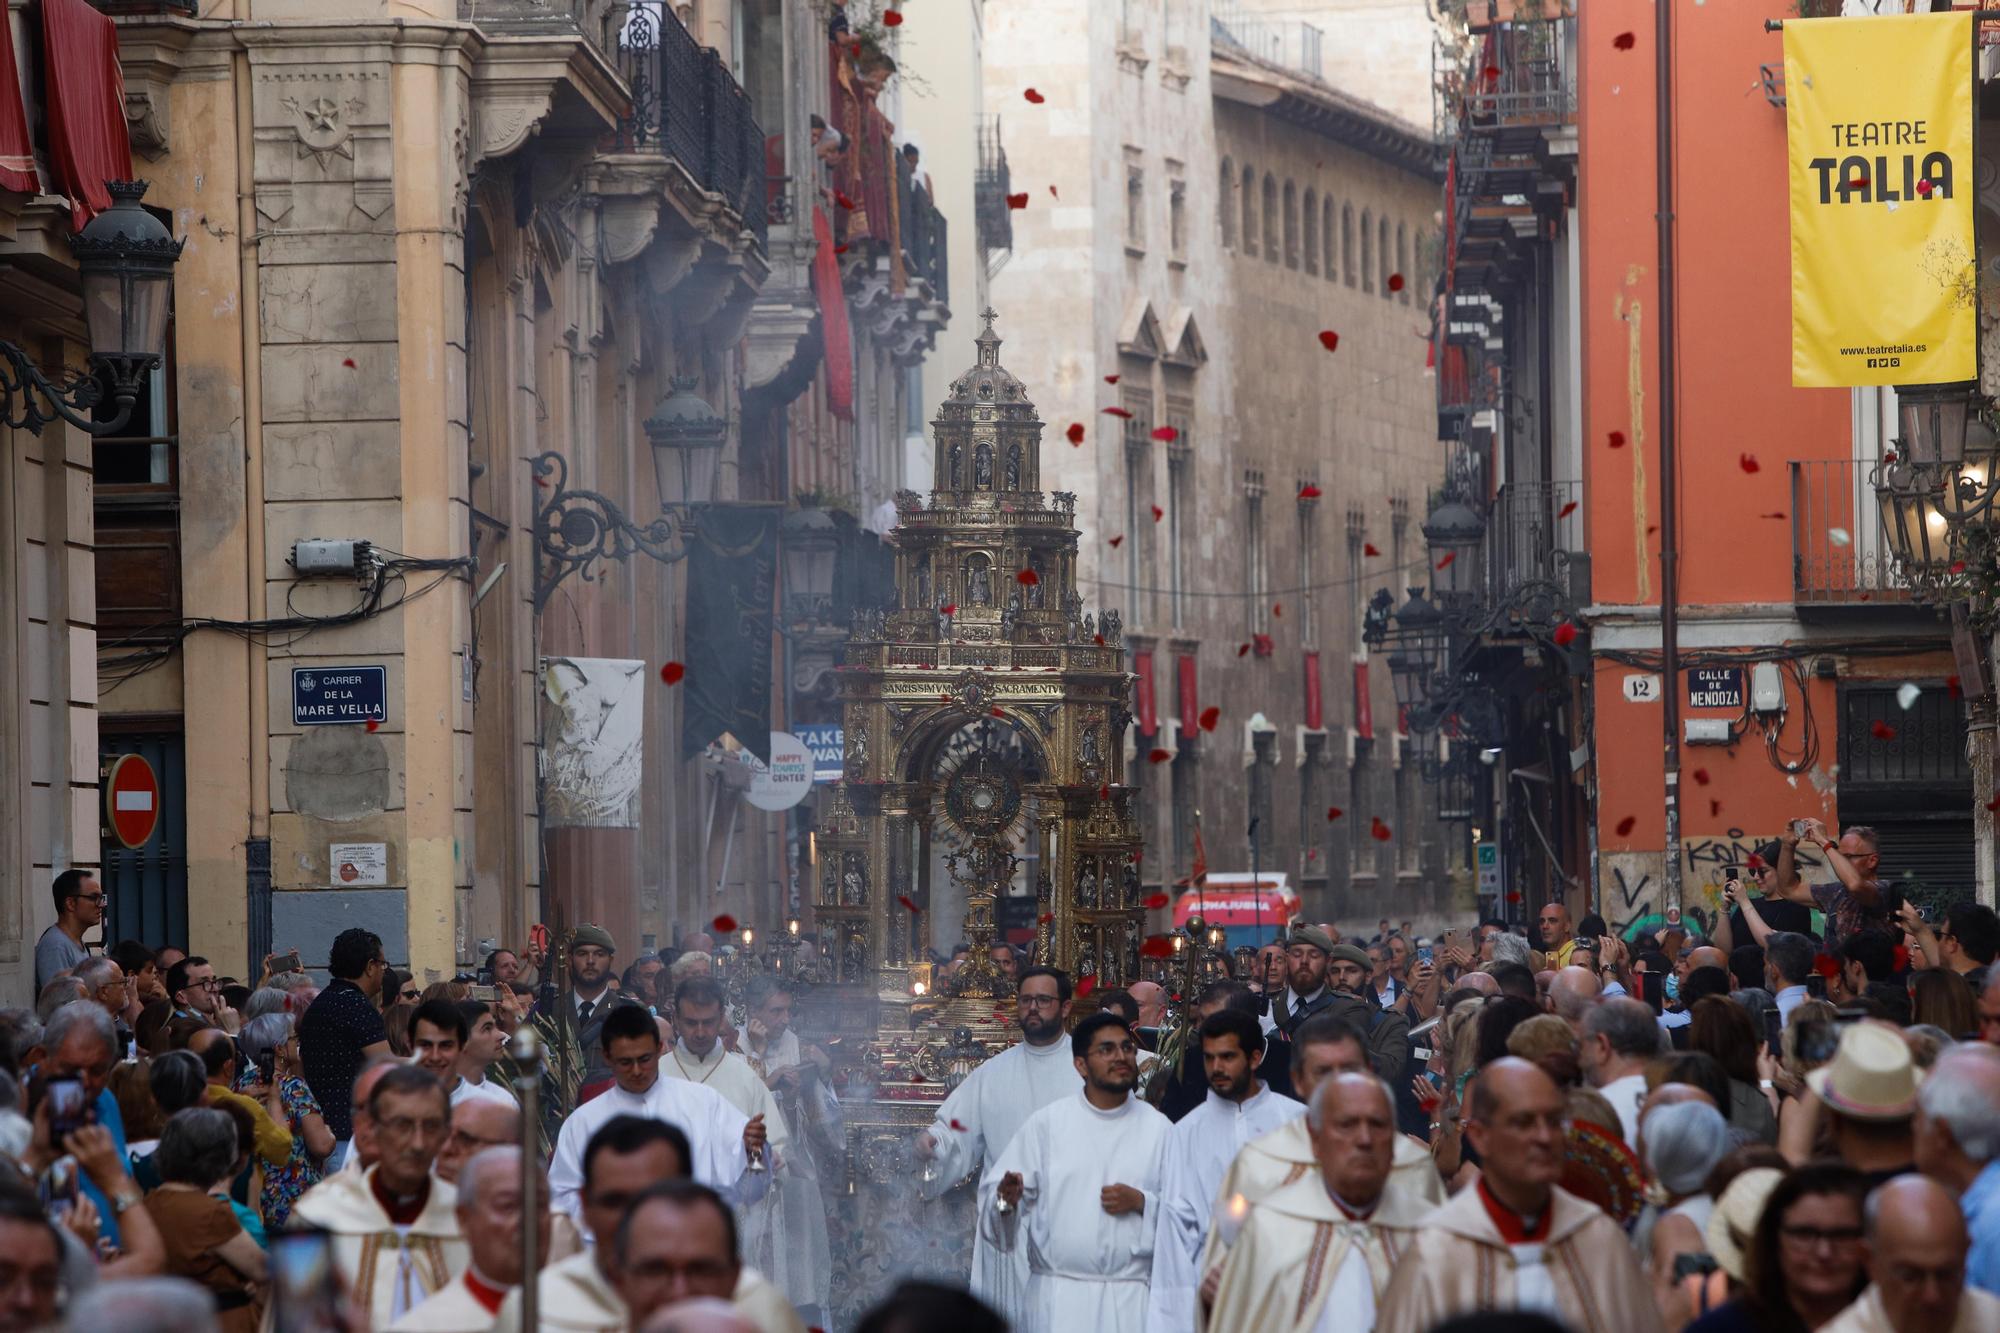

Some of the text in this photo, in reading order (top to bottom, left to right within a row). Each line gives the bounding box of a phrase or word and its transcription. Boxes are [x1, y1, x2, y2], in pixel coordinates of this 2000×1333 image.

[1832, 121, 1926, 147] TEATRE
[1808, 151, 1953, 204] TALIA
[1840, 344, 1927, 355] www.teatretalia.es
[322, 676, 362, 685] CARRER
[1699, 670, 1730, 680] CALLE
[1633, 680, 1650, 697] 12
[324, 690, 353, 699] DE LA
[1691, 691, 1740, 706] MENDOZA
[297, 703, 382, 716] MARE VELLA
[795, 730, 844, 746] TAKE
[775, 754, 802, 763] HAPPY
[772, 763, 806, 773] TOURIST
[772, 774, 807, 783] CENTER
